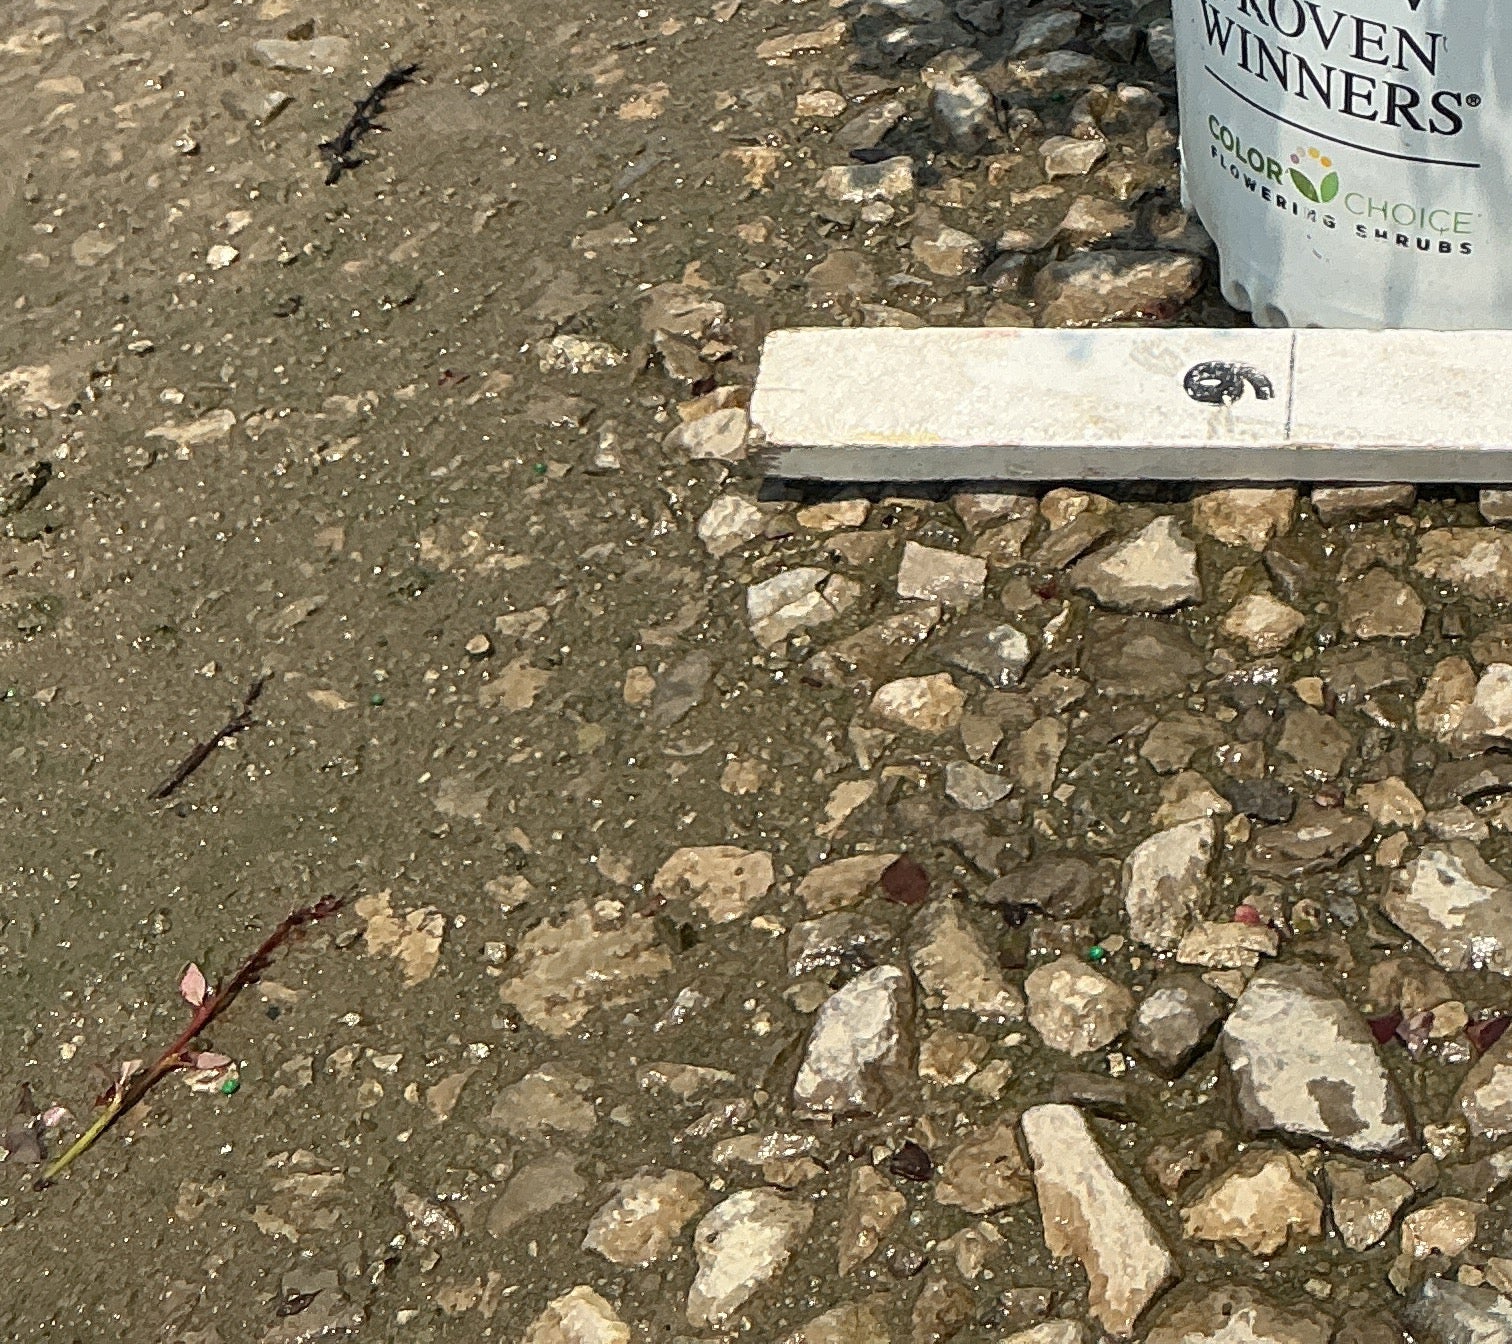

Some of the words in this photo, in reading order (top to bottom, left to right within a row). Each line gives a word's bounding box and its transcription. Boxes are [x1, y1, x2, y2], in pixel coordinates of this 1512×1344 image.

[1207, 114, 1284, 186] COLOR
[1343, 191, 1474, 236] CHOICE
[1209, 144, 1337, 229] FLOWERING
[1354, 223, 1473, 255] SHRUBS
